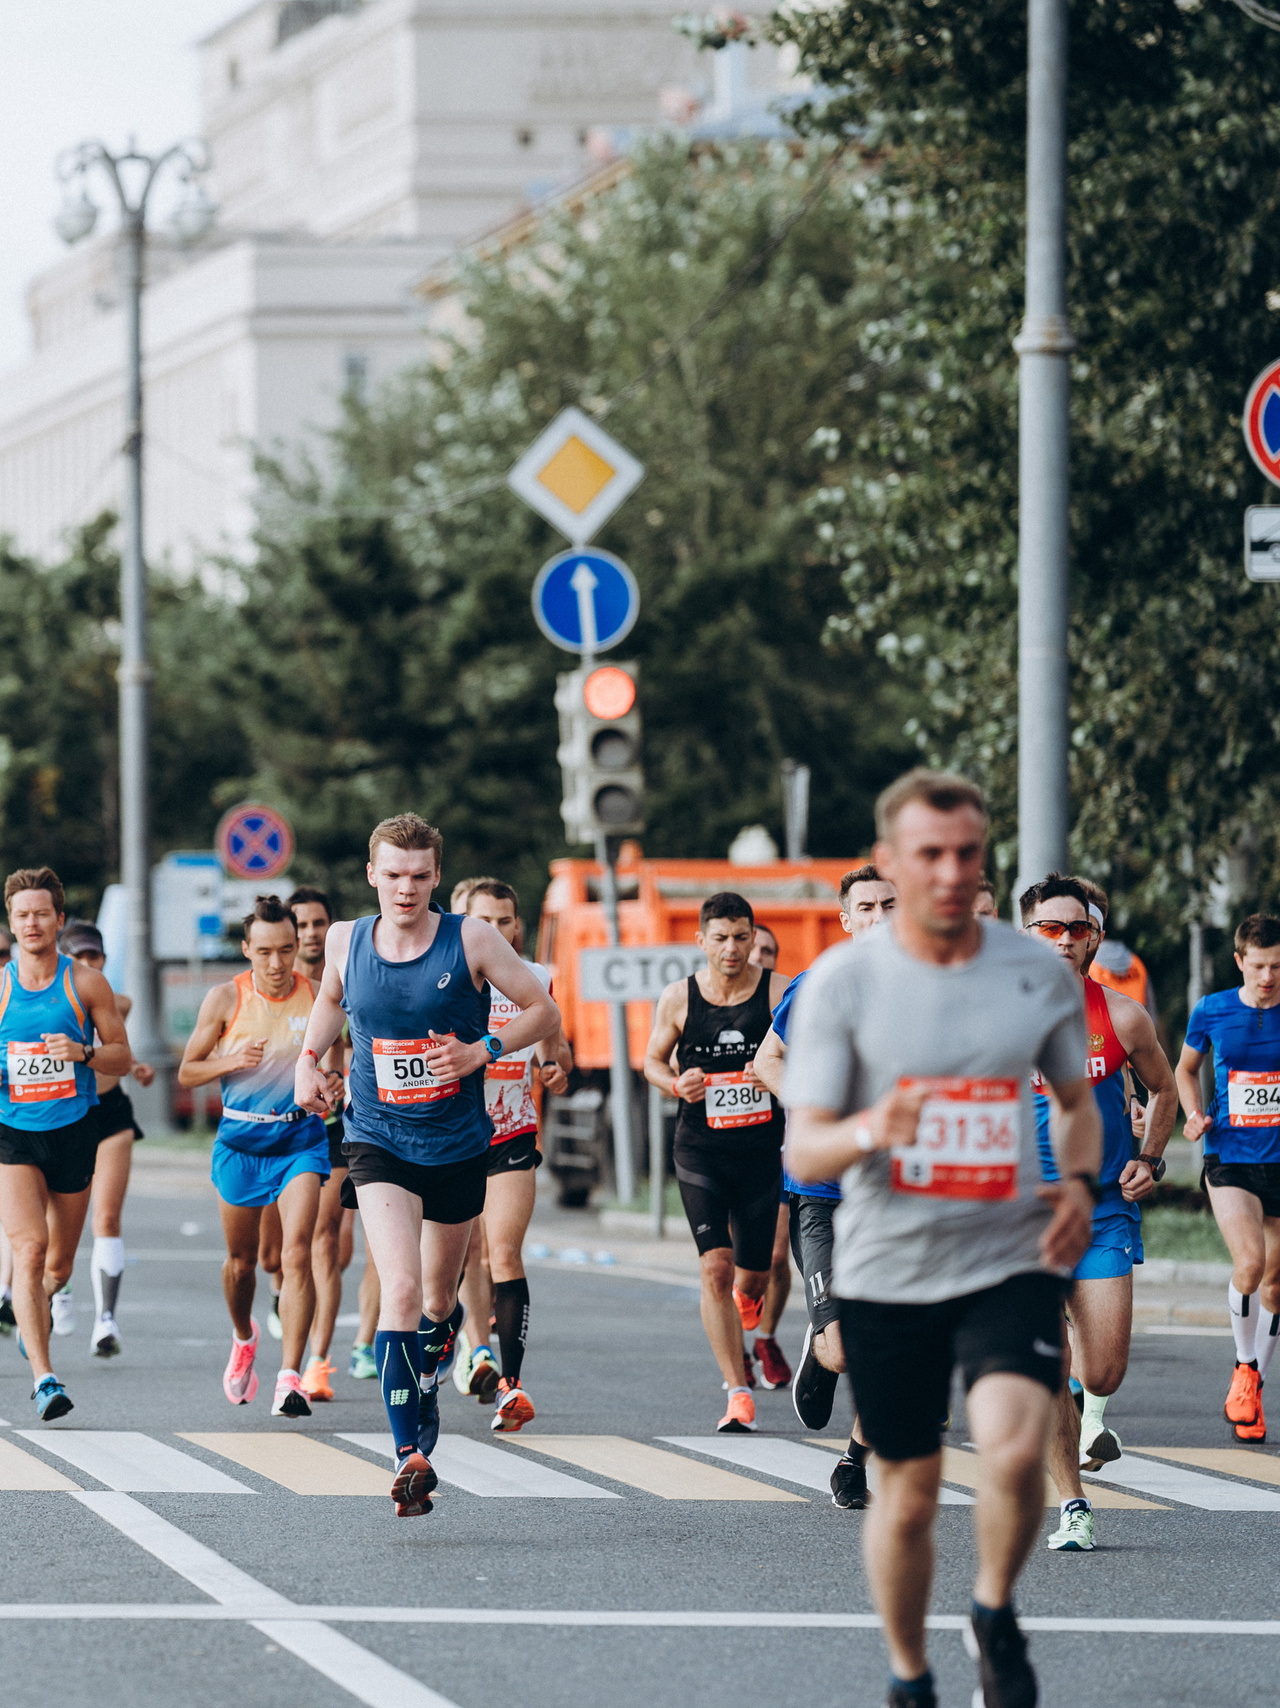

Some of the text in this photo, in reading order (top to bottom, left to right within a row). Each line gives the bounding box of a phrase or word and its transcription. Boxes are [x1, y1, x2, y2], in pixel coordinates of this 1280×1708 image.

[491, 1004, 523, 1013] ТОЛ
[17, 1058, 65, 1076] 2620
[402, 1079, 435, 1088] ANDREY
[714, 1087, 762, 1107] 2380
[925, 1115, 1015, 1151] 3136
